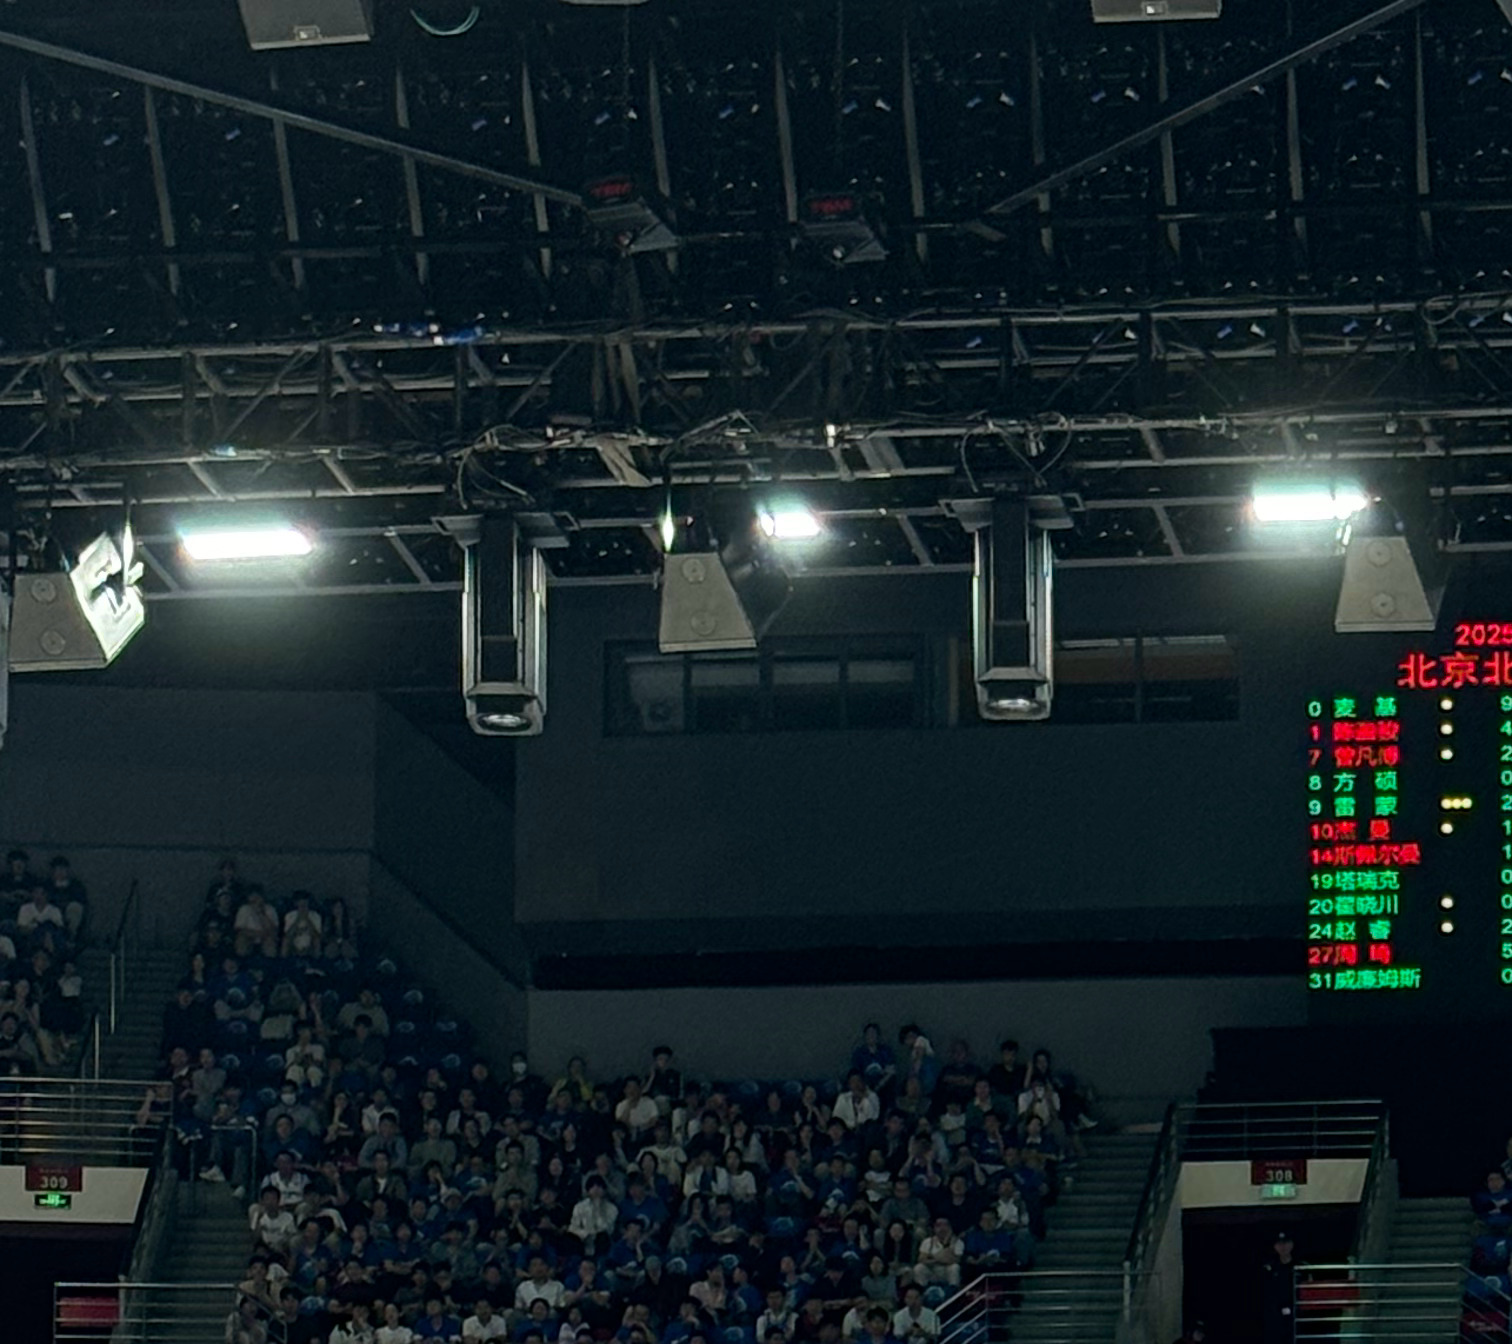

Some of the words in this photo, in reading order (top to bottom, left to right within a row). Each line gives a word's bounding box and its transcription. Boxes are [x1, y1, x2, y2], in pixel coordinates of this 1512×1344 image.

[1308, 701, 1322, 717] 0
[1501, 695, 1512, 711] 9
[1311, 724, 1319, 740] 1
[1501, 720, 1512, 736] 4
[1308, 749, 1321, 765] 7
[1501, 745, 1512, 761] 2
[1308, 775, 1322, 791] 8
[1501, 770, 1512, 786] 0
[1308, 800, 1321, 815] 9
[1502, 795, 1512, 811] 2
[1312, 825, 1332, 840] 10
[1312, 850, 1332, 865] 14
[1311, 874, 1332, 889] 19
[1335, 871, 1399, 891] 塔瑞克
[1309, 899, 1333, 914] 20
[1309, 924, 1332, 939] 24
[1309, 949, 1333, 964] 27
[1309, 974, 1332, 989] 31
[39, 1175, 68, 1190] 309
